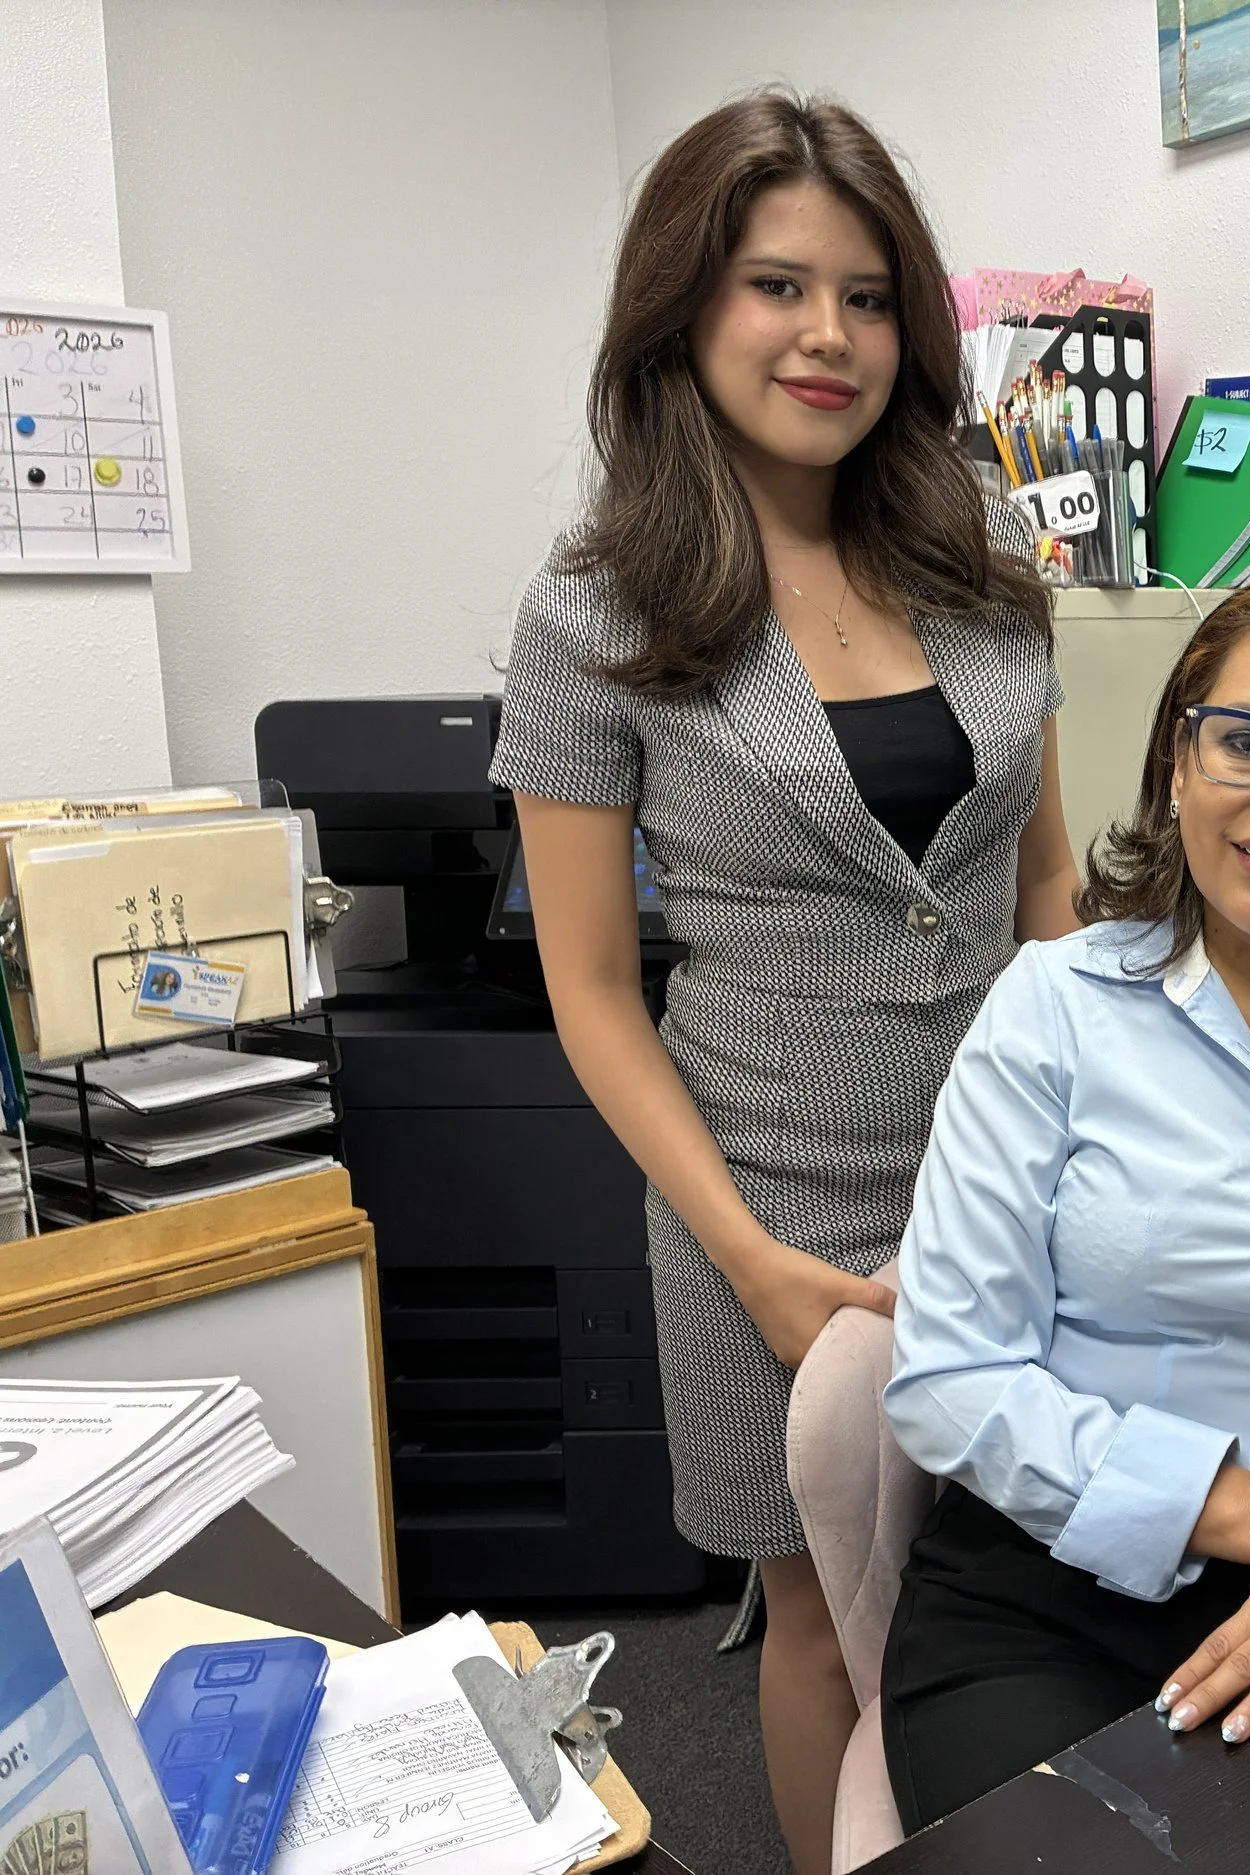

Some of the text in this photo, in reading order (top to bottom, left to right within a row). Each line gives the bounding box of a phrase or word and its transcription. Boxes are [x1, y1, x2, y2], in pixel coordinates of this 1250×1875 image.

[55, 327, 124, 353] 2026
[129, 385, 144, 425] 4
[1225, 389, 1249, 399] 1-SUBJECT
[64, 428, 85, 455] 10
[142, 435, 154, 462] 11
[1194, 428, 1227, 455] $2
[64, 465, 82, 489] 17
[136, 468, 159, 497] 18
[60, 504, 94, 527] 24
[136, 507, 166, 531] 25
[373, 1792, 454, 1839] Group 8
